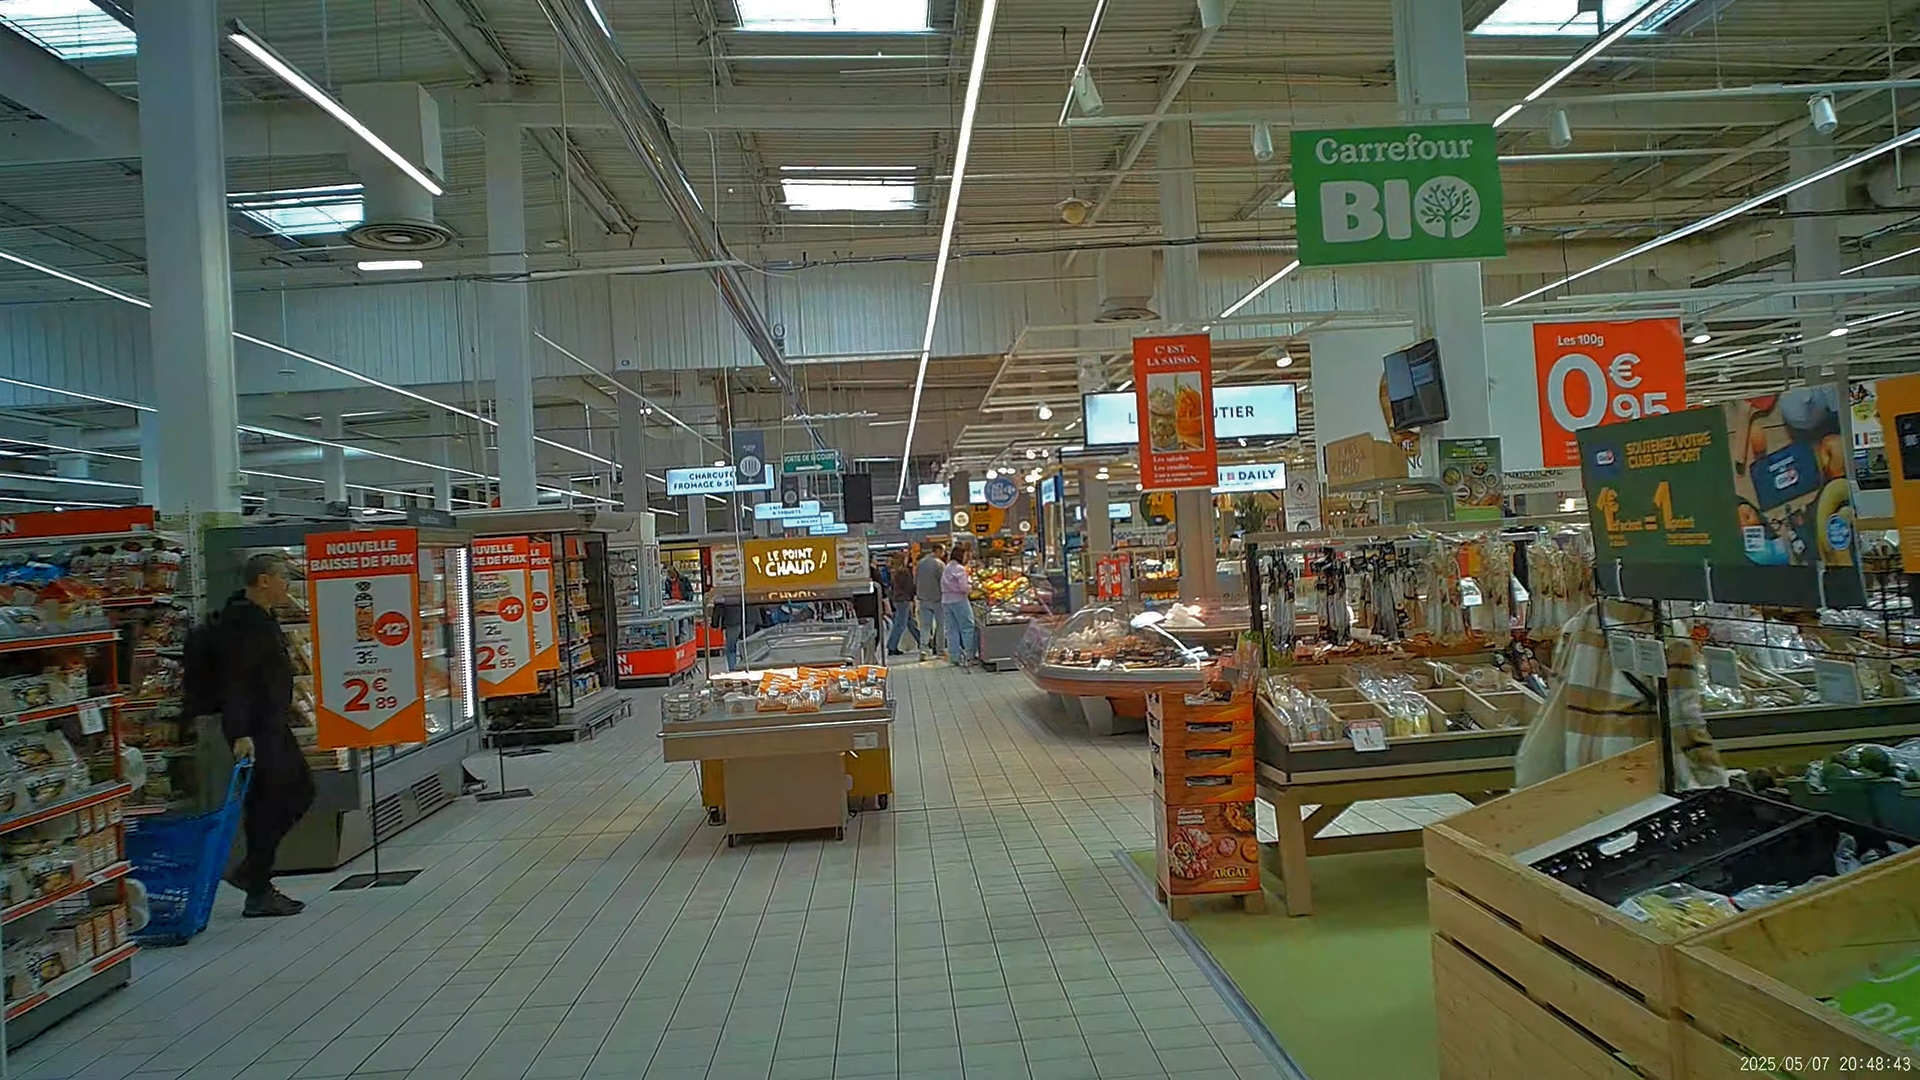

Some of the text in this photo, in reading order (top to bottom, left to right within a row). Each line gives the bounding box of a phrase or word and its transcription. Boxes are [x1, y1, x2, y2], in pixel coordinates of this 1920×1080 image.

[1315, 132, 1474, 165] Carrefour
[1319, 174, 1481, 243] BIO
[1557, 333, 1604, 347] Les 100g
[1147, 357, 1163, 366] LA
[1625, 431, 1712, 456] SOUTENEZ VOTRE
[1628, 452, 1652, 469] CLUB
[1653, 451, 1668, 466] DE
[1668, 447, 1702, 464] SPORT
[1238, 469, 1276, 480] DAILY
[673, 481, 714, 490] FROMAGE
[326, 540, 397, 555] NOUVELLE
[766, 547, 814, 562] LE POINT
[310, 553, 414, 572] BAISSE DE PRIX
[487, 556, 501, 565] DE
[502, 554, 527, 564] PRIX
[530, 557, 550, 565] PRIX
[765, 558, 816, 577] CHAUD
[1212, 867, 1249, 879] ARGAL
